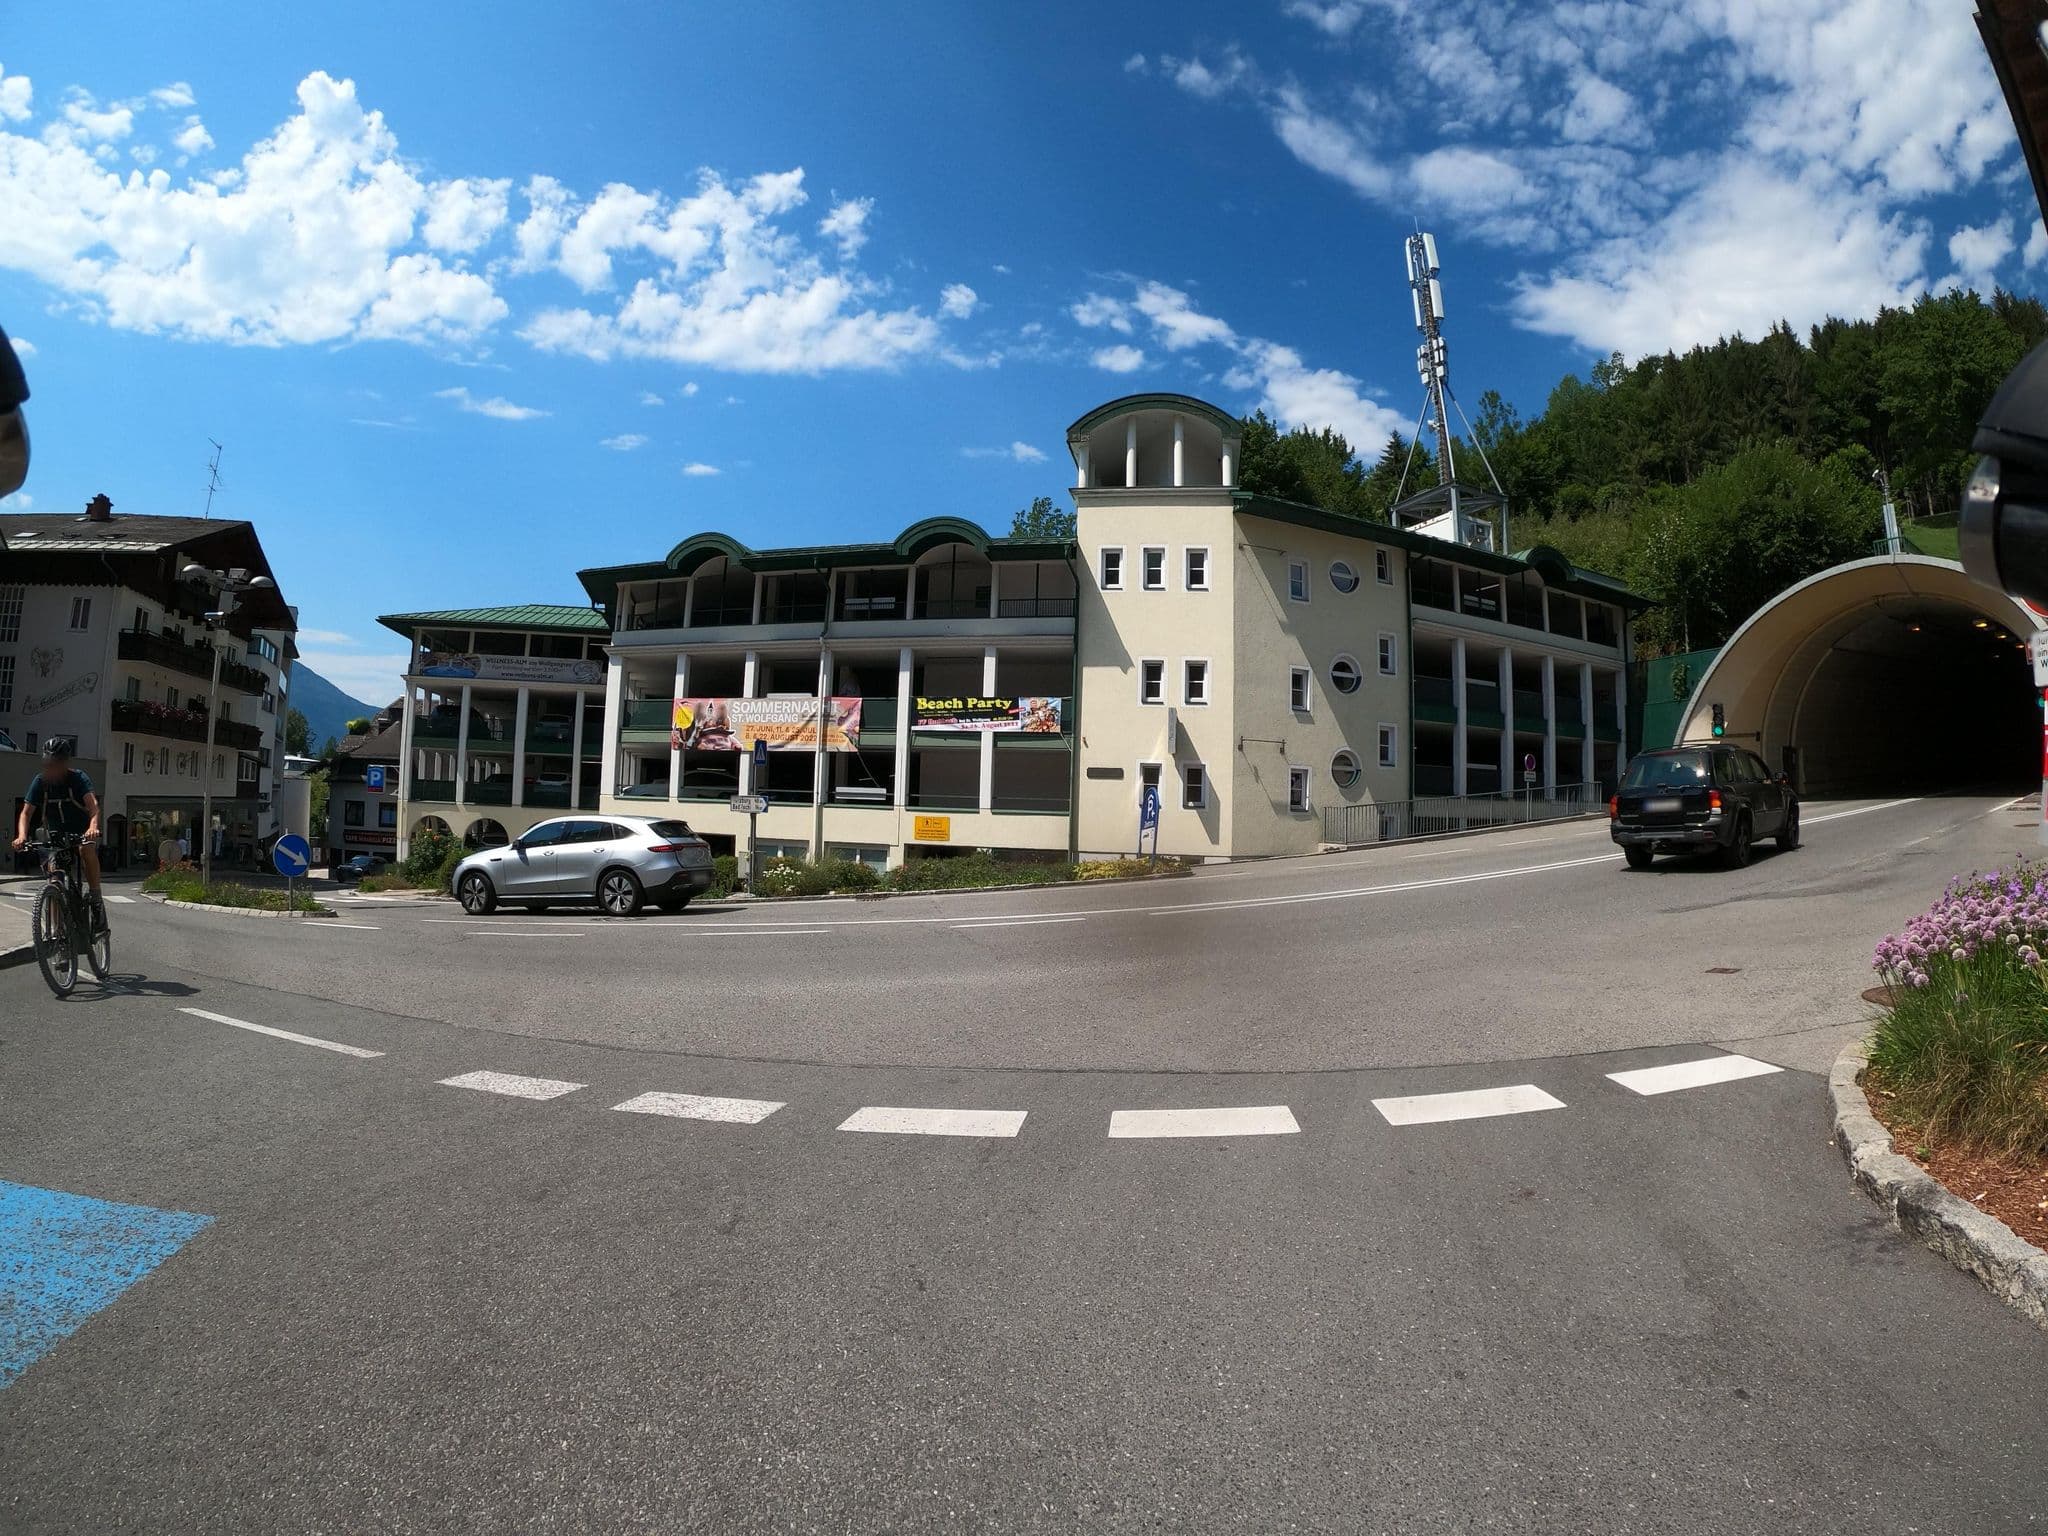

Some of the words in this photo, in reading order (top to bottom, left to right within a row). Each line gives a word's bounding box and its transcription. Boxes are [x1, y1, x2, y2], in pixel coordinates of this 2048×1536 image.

[916, 697, 963, 710] Beach
[967, 696, 1013, 710] Party
[731, 713, 744, 723] ST.
[745, 713, 799, 723] WOLFGANG
[770, 733, 799, 742] AUGUST
[370, 771, 382, 787] P
